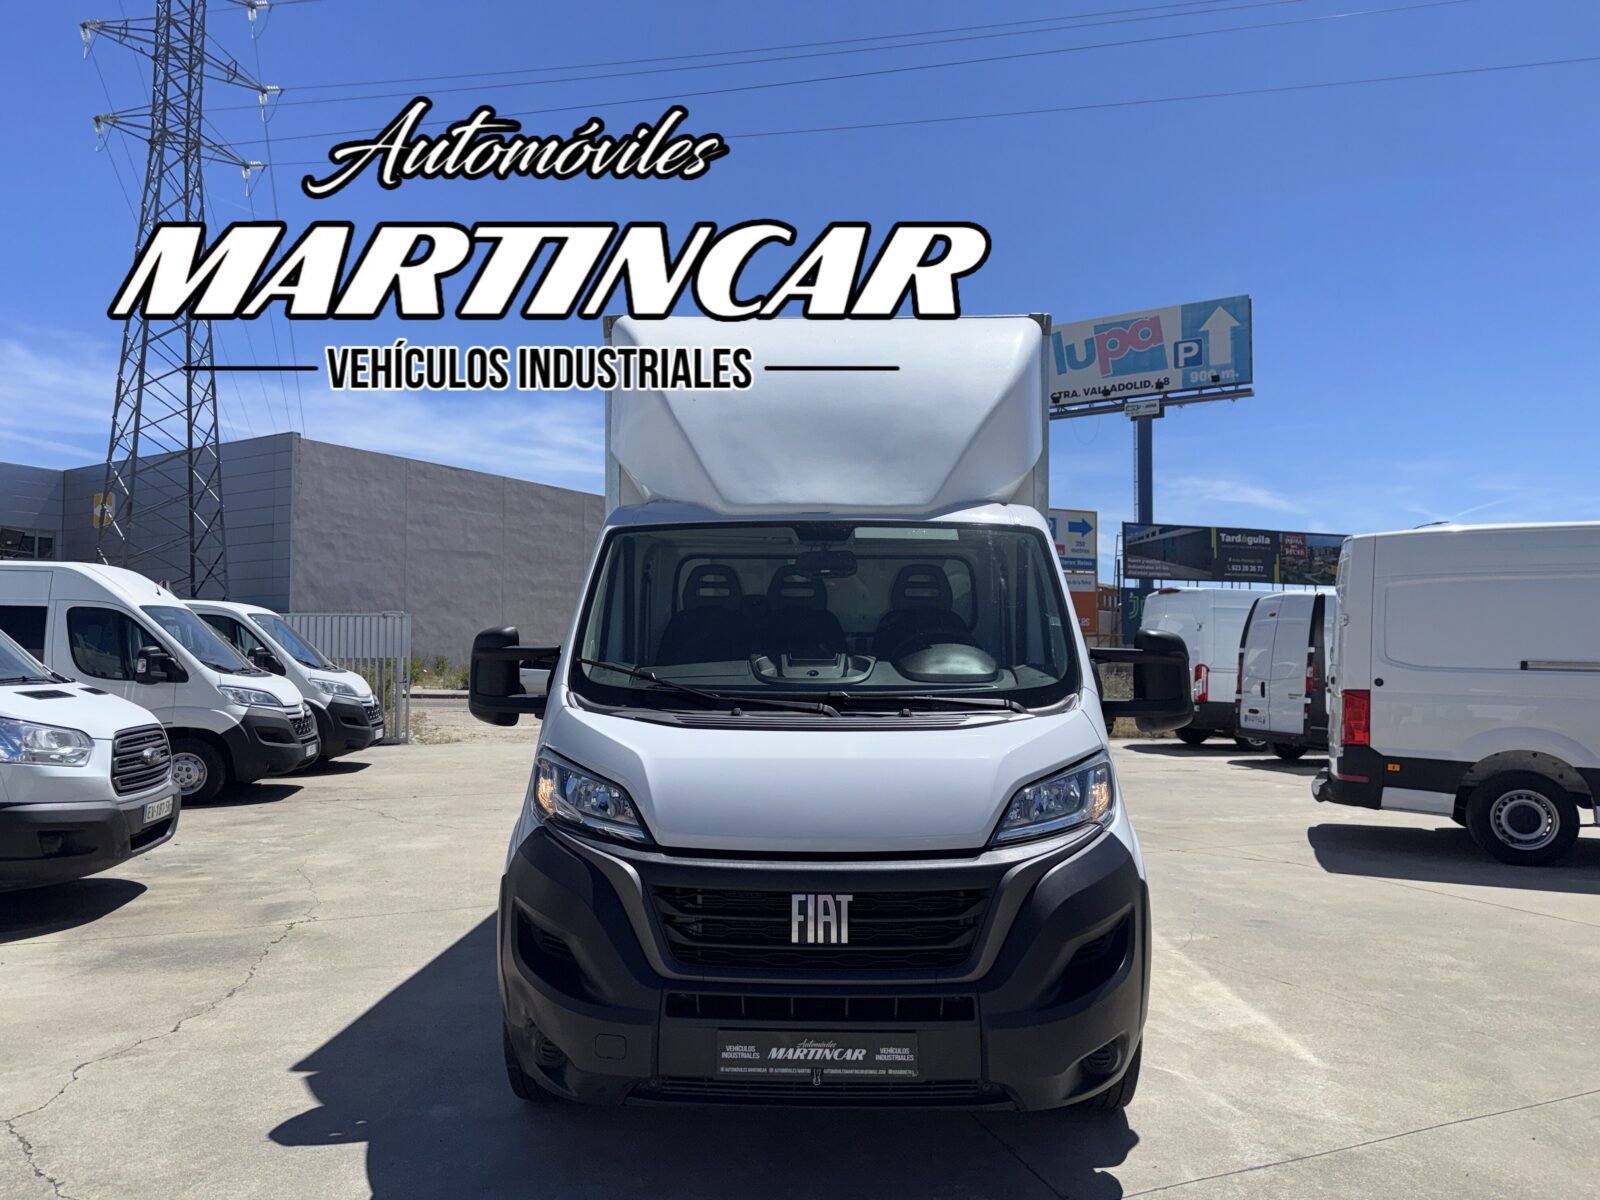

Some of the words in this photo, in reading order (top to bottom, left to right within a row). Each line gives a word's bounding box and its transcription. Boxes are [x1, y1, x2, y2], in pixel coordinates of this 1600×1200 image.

[1052, 315, 1164, 375] lupa
[1178, 342, 1199, 367] P
[1050, 389, 1081, 401] CTRA.
[792, 894, 853, 943] FIAT
[725, 1044, 756, 1052] VEHÍCULOS
[768, 1047, 867, 1061] MARTINCAR
[721, 1052, 760, 1060] INDUSTRIALES
[875, 1053, 914, 1062] INDUSTRIALES
